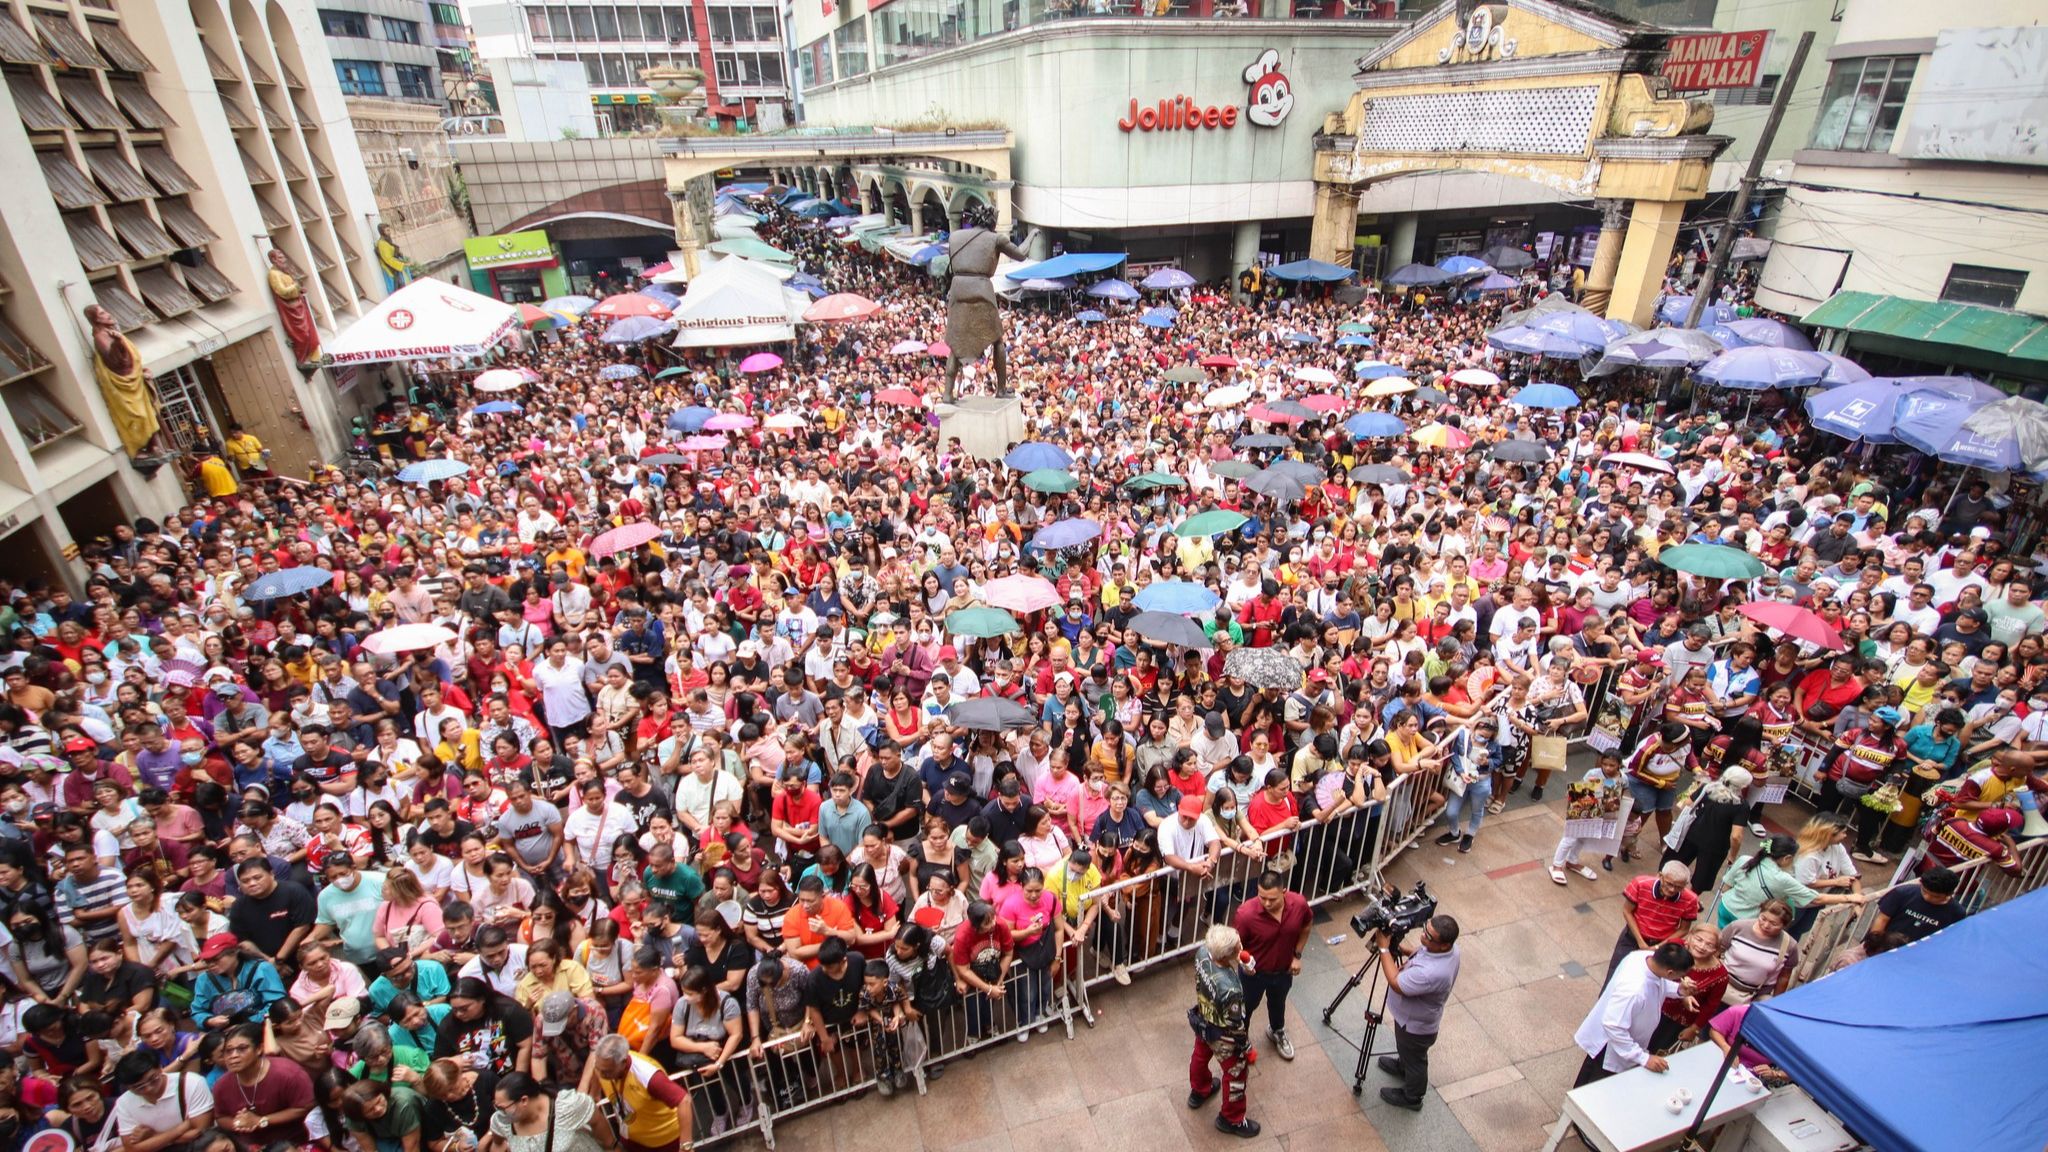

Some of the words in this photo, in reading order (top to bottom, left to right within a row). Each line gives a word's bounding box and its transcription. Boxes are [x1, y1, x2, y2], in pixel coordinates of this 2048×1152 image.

[1668, 35, 1738, 62] MANILA
[1664, 63, 1697, 87] CITY
[1698, 60, 1753, 86] PLAZA
[1118, 94, 1238, 132] Jollibee
[678, 317, 744, 329] Religious
[747, 315, 787, 325] Items
[334, 351, 372, 364] FIRST
[374, 348, 397, 359] AID
[400, 345, 451, 357] STATION
[1905, 908, 1939, 926] NAUTICA
